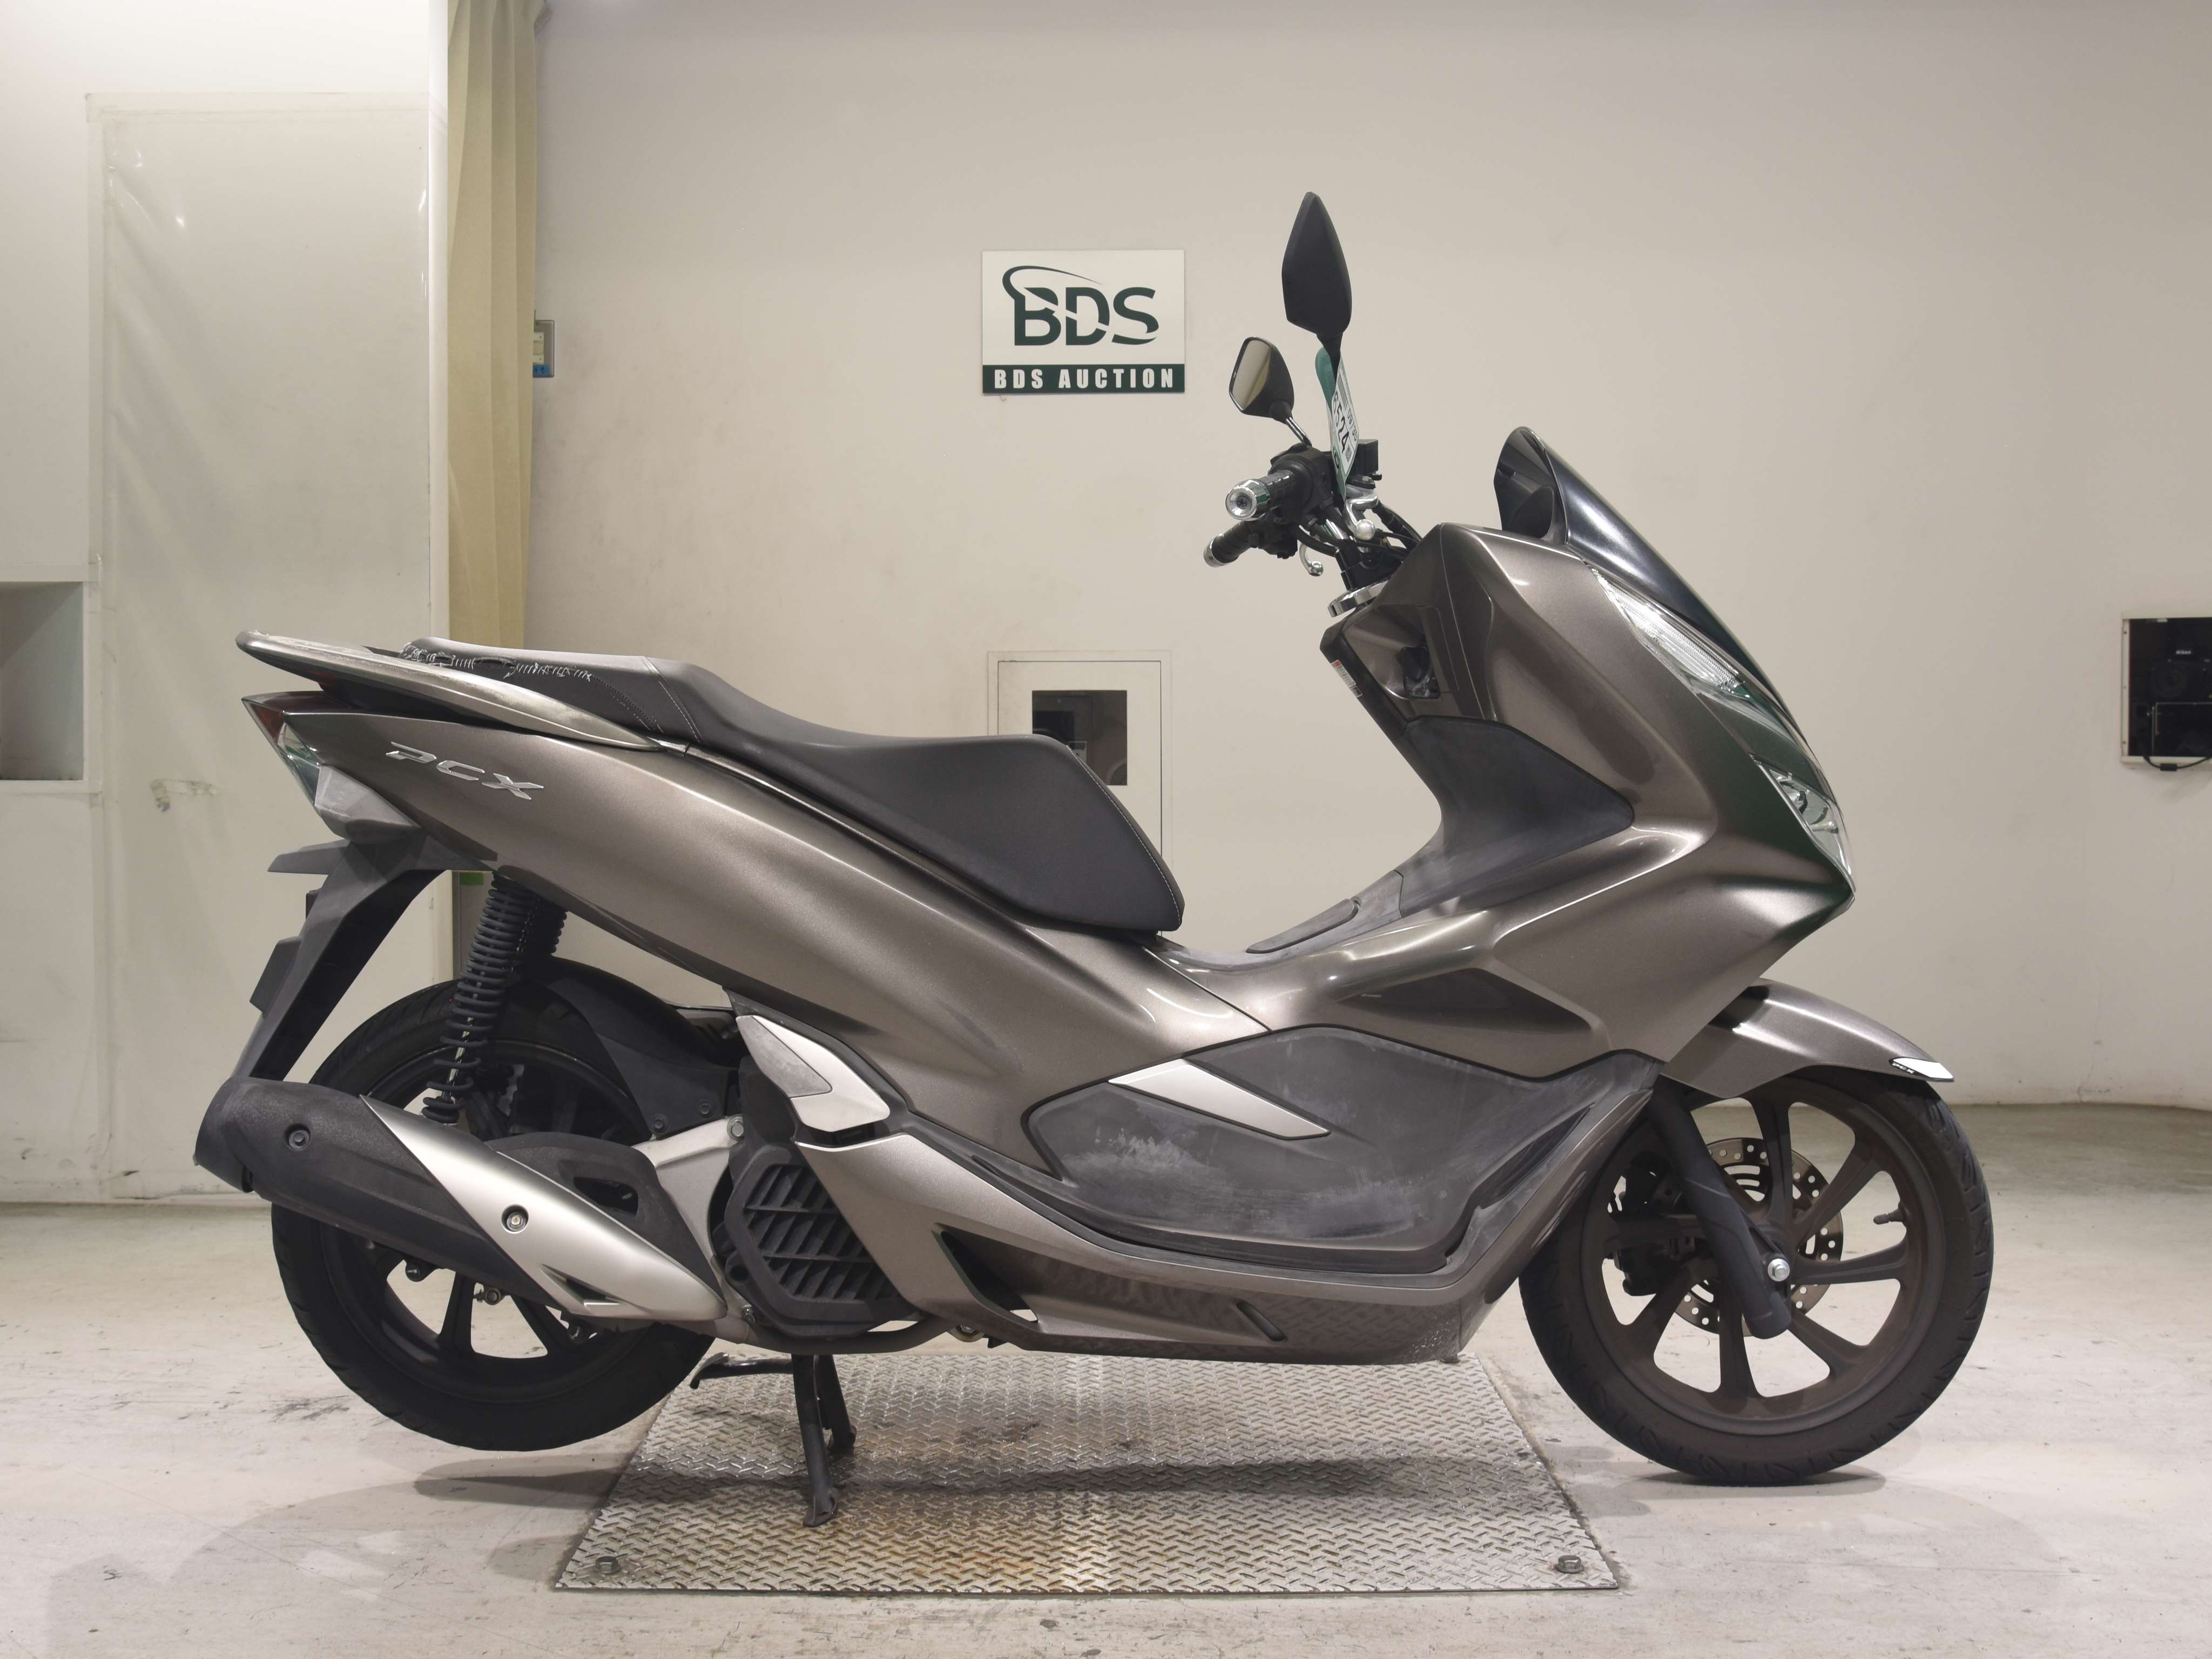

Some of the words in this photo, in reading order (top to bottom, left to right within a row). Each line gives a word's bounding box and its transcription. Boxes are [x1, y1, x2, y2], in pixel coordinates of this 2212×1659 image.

[1002, 265, 1159, 346] BDS
[994, 369, 1043, 389] BDS
[1058, 368, 1173, 389] AUCTION
[386, 741, 544, 800] PCX
